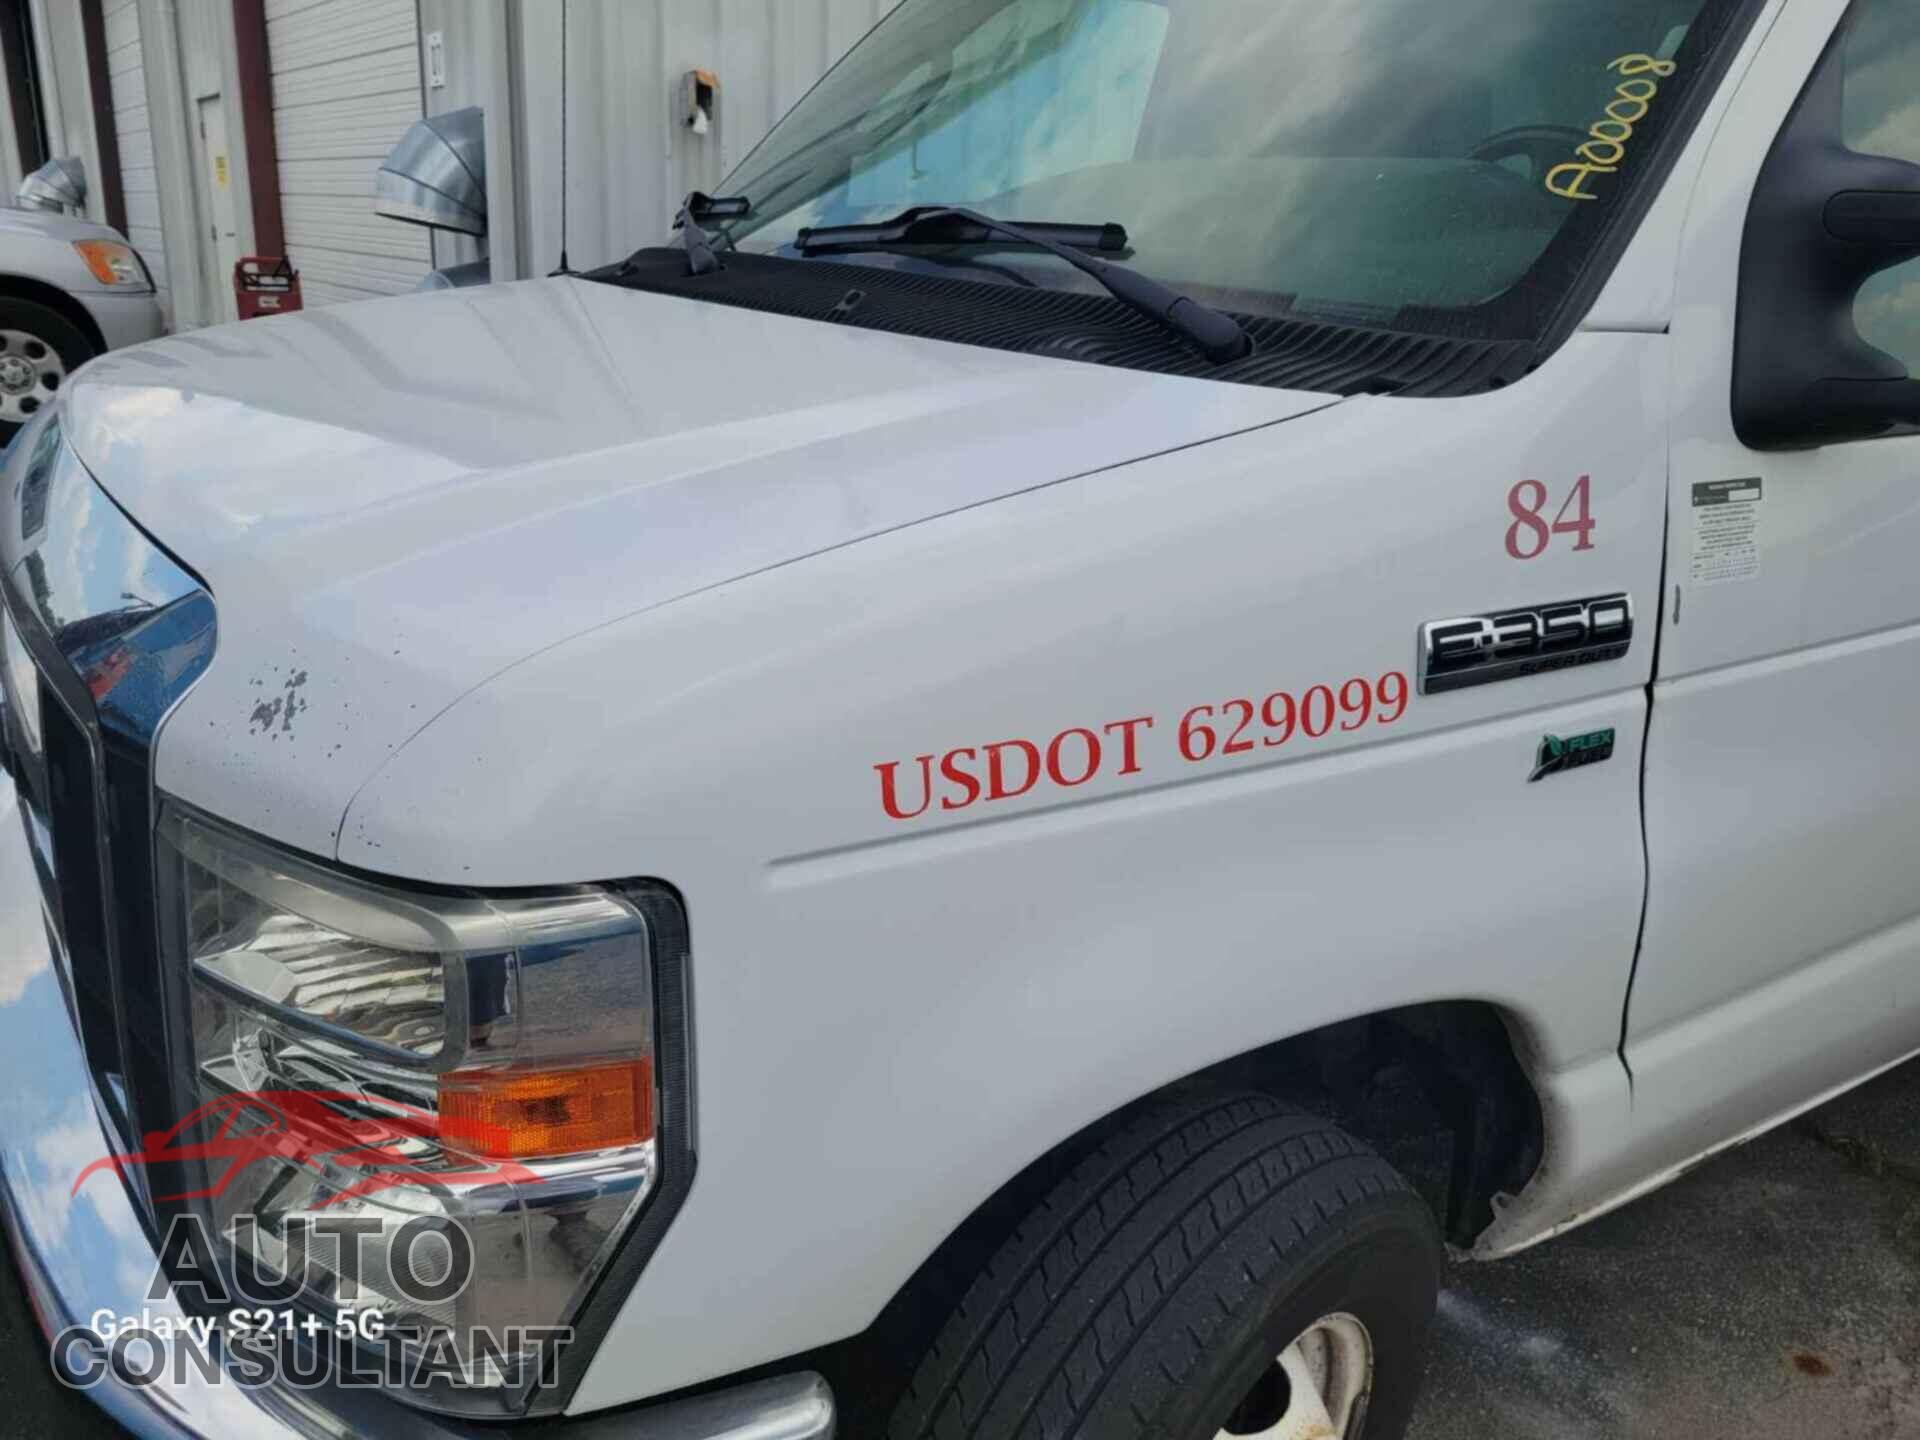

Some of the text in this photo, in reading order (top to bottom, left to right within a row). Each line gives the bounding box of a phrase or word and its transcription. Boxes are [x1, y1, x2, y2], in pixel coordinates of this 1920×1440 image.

[1545, 53, 1676, 200] A00008
[1504, 474, 1596, 559] 84
[874, 671, 1409, 820] USDOT 629099
[1568, 731, 1613, 752] FLEX
